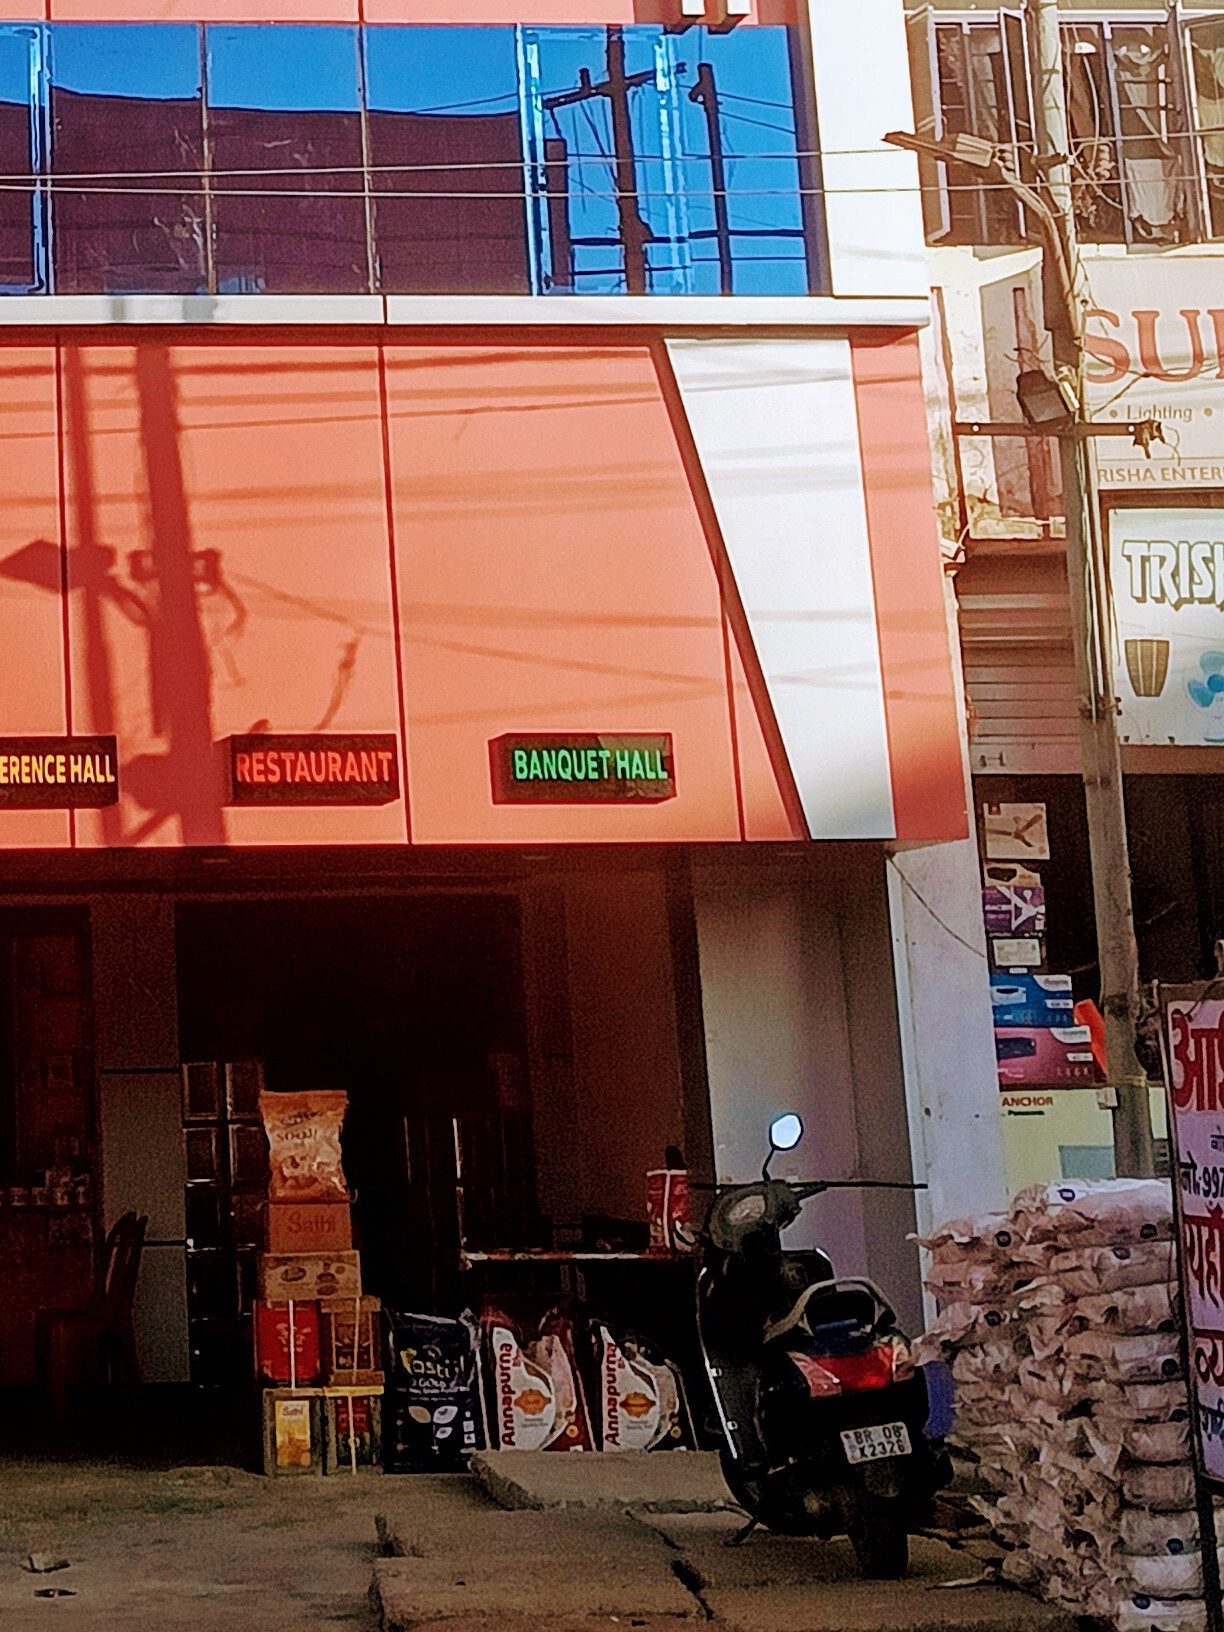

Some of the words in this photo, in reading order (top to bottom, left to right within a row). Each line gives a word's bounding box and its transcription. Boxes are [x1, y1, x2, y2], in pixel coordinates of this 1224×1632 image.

[1127, 405, 1192, 423] Lighting
[1097, 468, 1156, 482] RISHA
[1161, 467, 1224, 481] ENTER
[70, 753, 115, 783] HALL
[236, 750, 392, 785] RESTAURANT
[513, 748, 611, 781] BANQUET
[615, 746, 668, 780] HALL
[1002, 1097, 1053, 1106] ANCHOR
[287, 1212, 337, 1234] Sathi
[500, 1343, 516, 1446] Annapurna
[605, 1342, 620, 1445] Annapurna
[854, 1430, 874, 1445] BR
